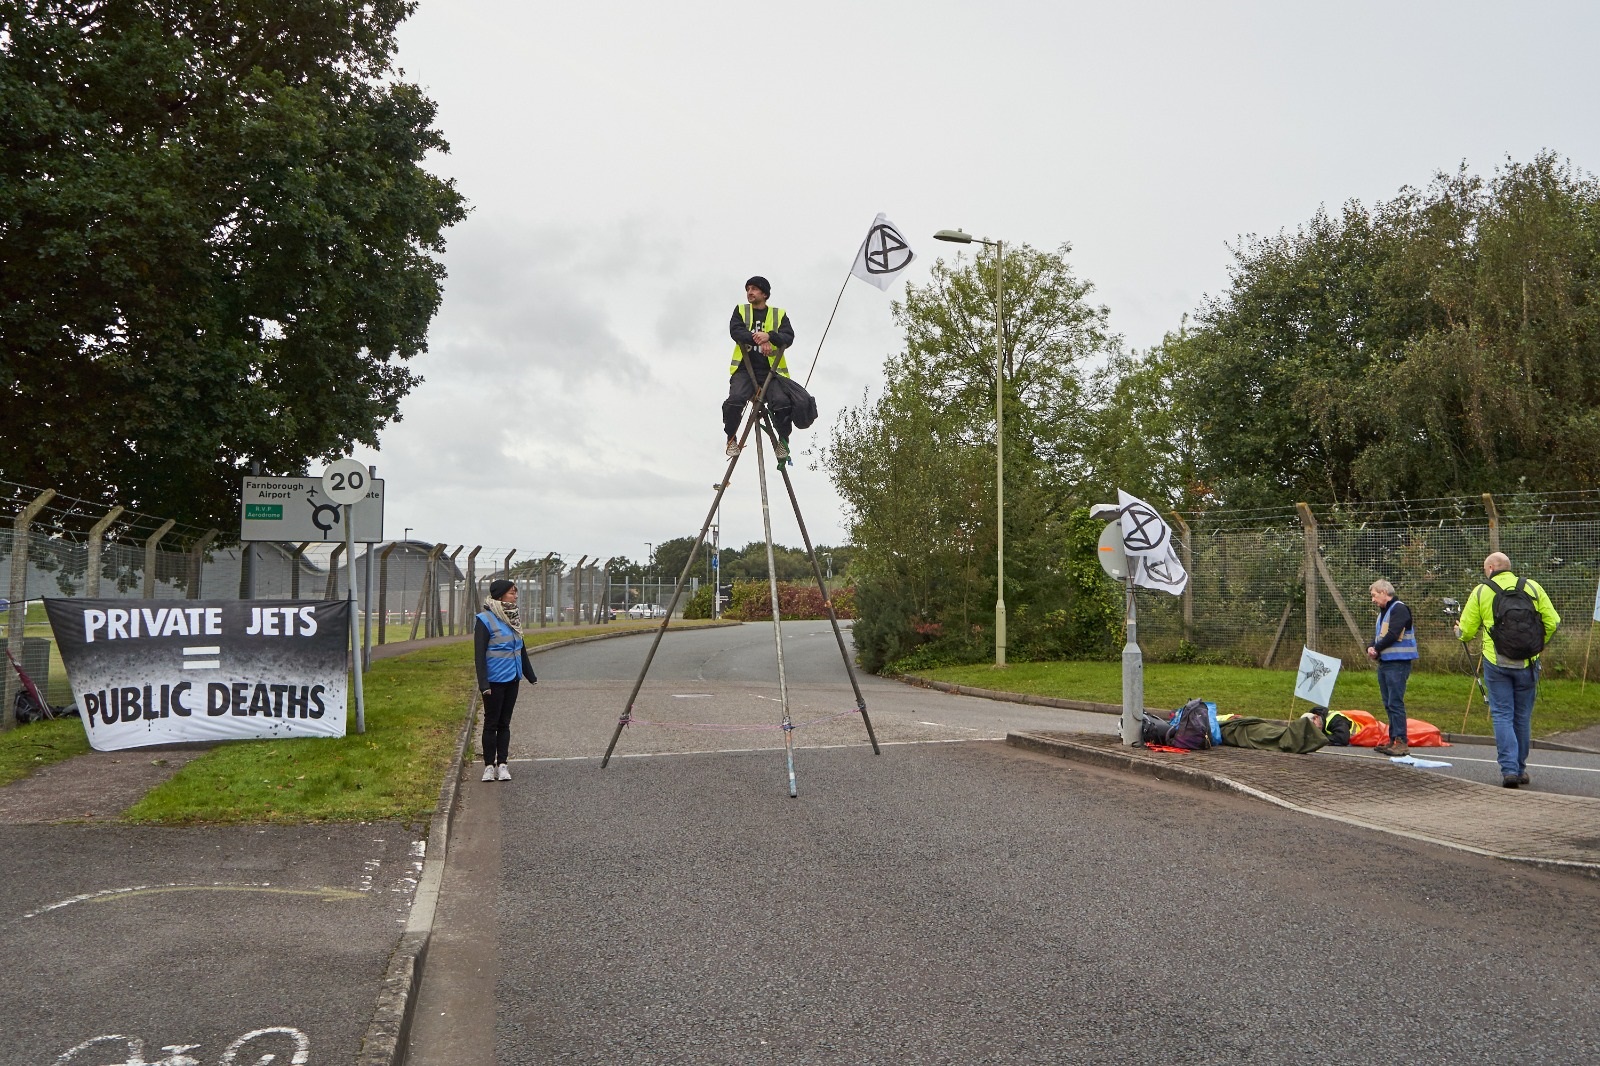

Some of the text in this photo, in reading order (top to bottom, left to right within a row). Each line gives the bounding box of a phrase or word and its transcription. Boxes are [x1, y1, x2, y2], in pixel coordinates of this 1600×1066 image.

[246, 481, 304, 491] Farnborough
[330, 471, 364, 491] 20
[258, 490, 291, 499] Airport
[364, 491, 380, 499] ate
[83, 605, 318, 643] PRIVATE JETS
[182, 646, 220, 670] =
[83, 681, 326, 729] PUBLIC DEATHS
